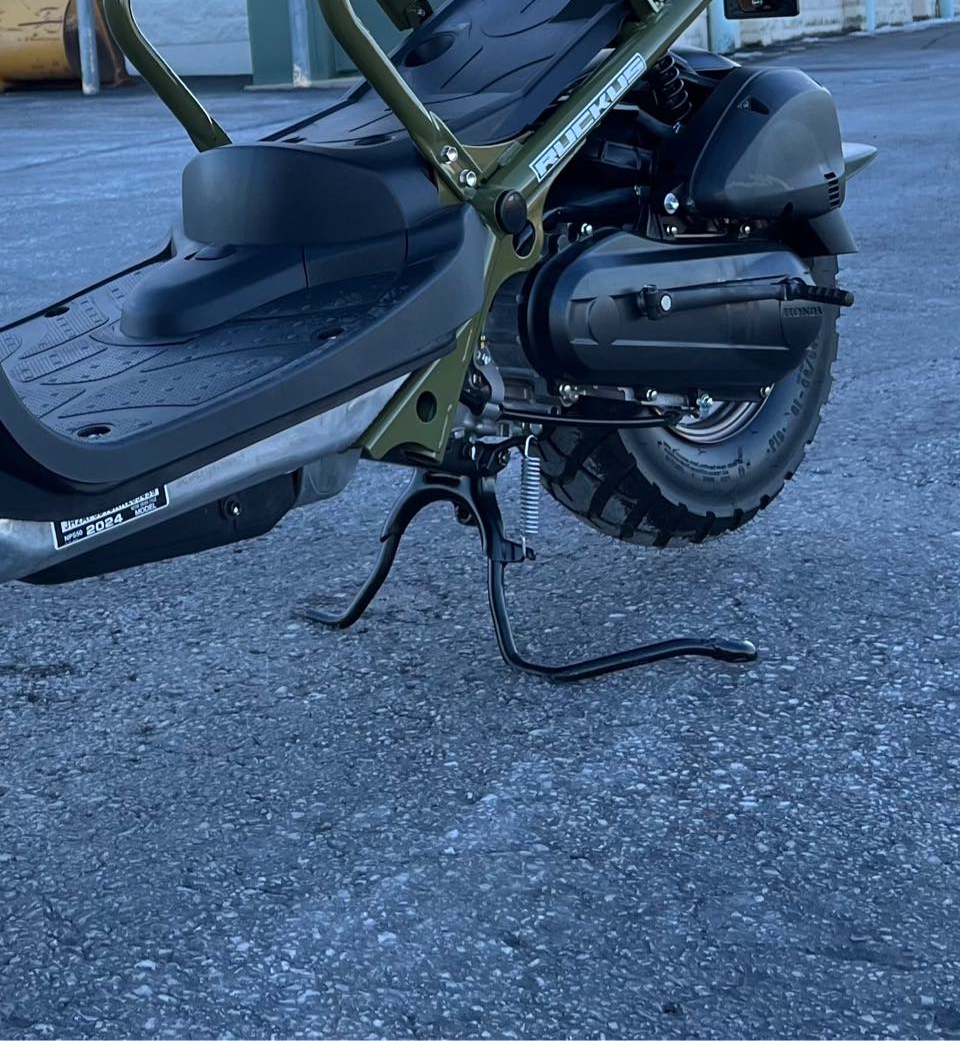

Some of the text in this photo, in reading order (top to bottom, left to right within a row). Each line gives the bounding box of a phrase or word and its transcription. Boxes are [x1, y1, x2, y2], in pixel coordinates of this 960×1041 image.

[534, 56, 644, 177] RUCKUS
[782, 305, 824, 318] HONDA
[86, 513, 123, 536] 2024
[134, 503, 157, 516] MODEL
